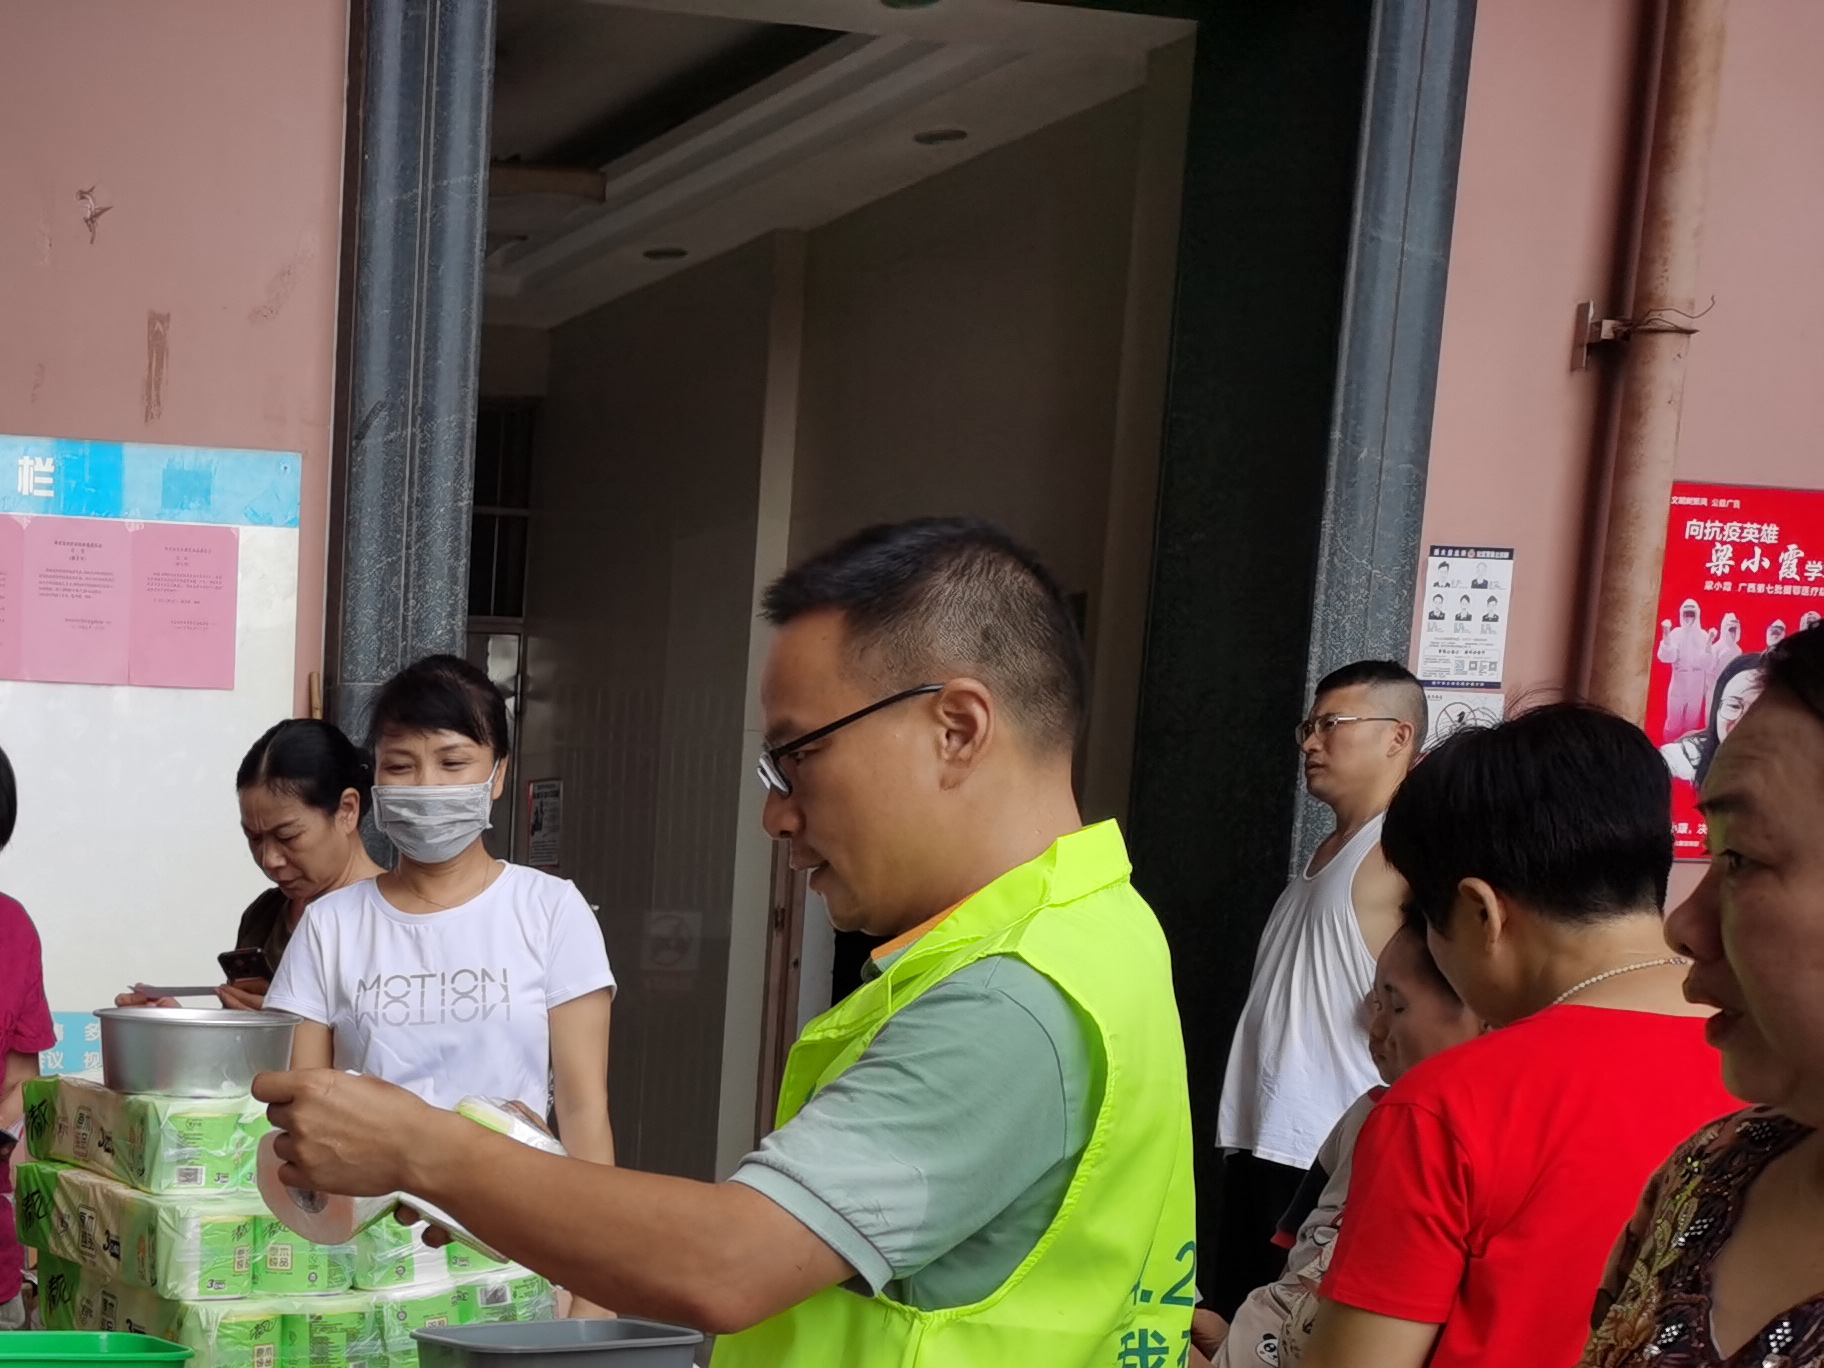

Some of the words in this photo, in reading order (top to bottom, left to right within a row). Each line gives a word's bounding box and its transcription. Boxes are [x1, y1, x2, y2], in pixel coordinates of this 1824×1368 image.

[1684, 518, 1780, 545] 向抗疫英雄
[1705, 542, 1824, 582] 梁小霞学
[354, 967, 510, 1003] MOTION
